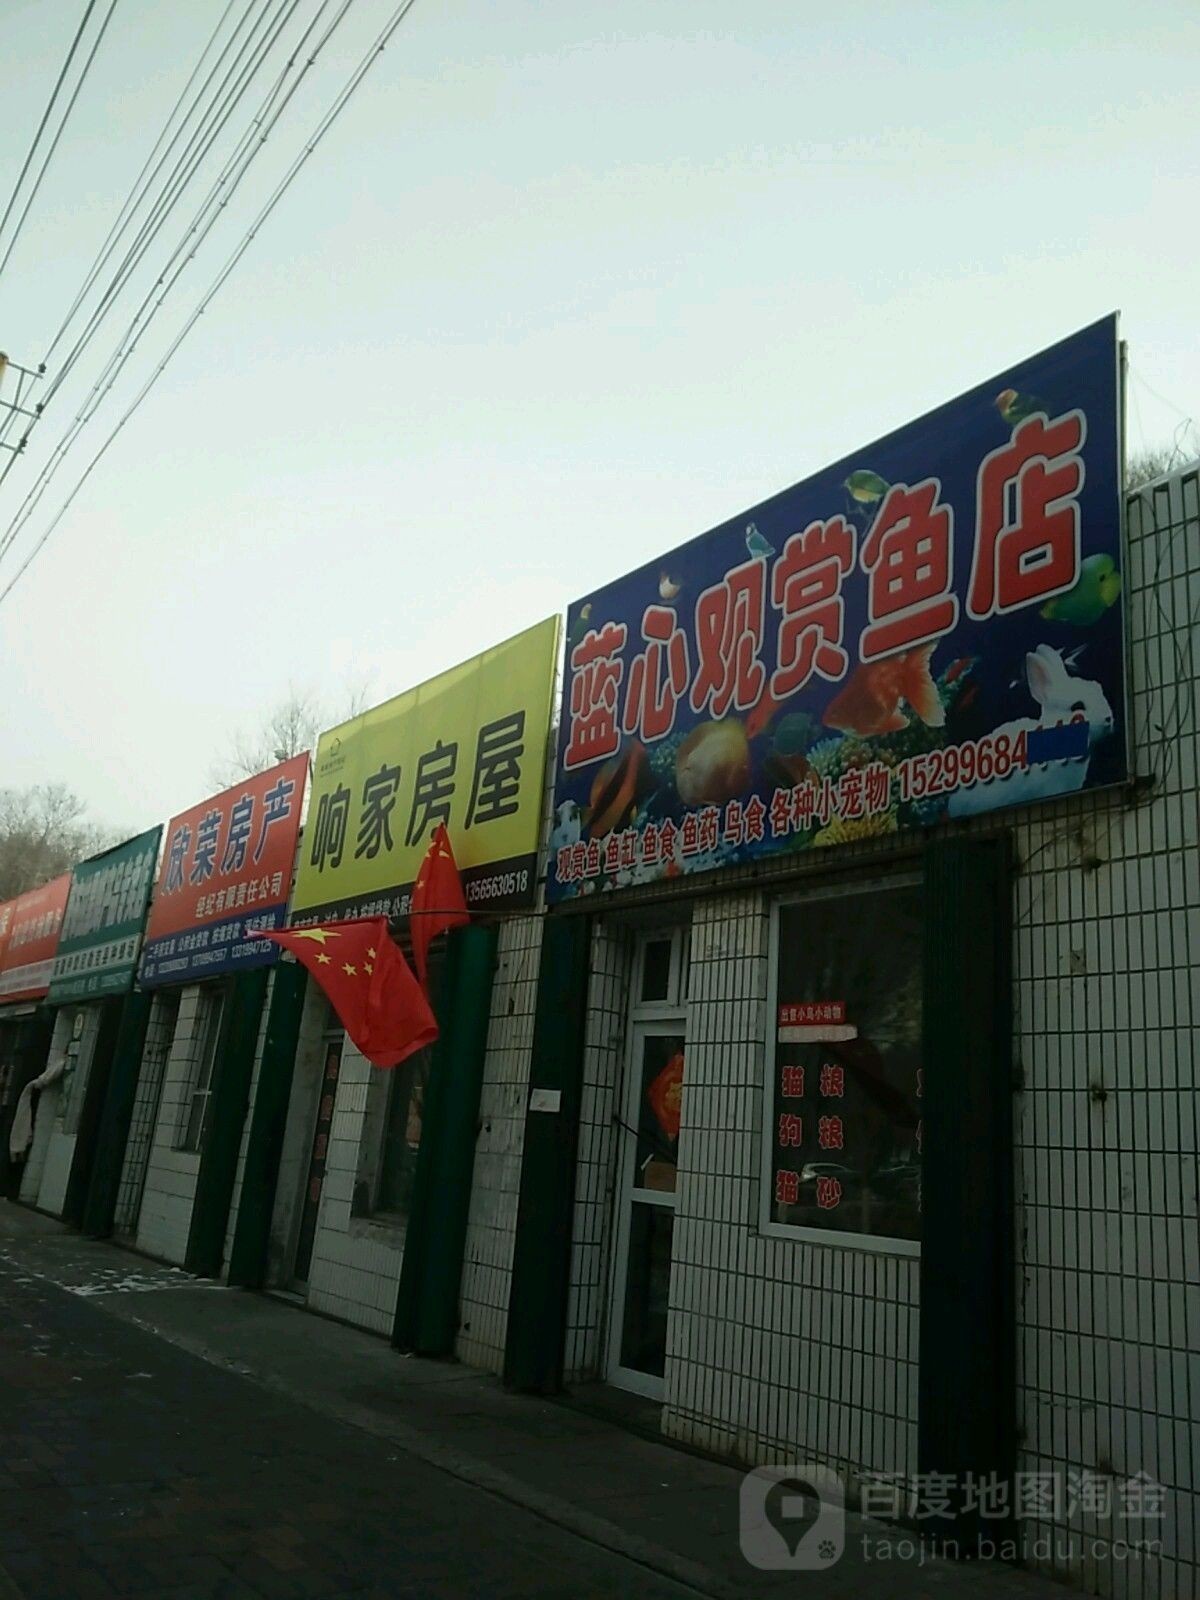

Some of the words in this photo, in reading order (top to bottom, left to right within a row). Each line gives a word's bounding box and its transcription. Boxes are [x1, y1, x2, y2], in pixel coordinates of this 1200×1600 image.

[563, 409, 1087, 771] 蓝心观赏鱼店
[161, 776, 296, 896] 欣荣房产
[310, 709, 526, 873] 响家房屋
[555, 836, 600, 883] 观赏鱼
[603, 826, 637, 874] 鱼缸
[641, 817, 677, 867] 鱼食
[681, 808, 720, 854] 鱼药
[724, 794, 766, 846] 鸟食
[770, 761, 891, 838] 各种小宠物
